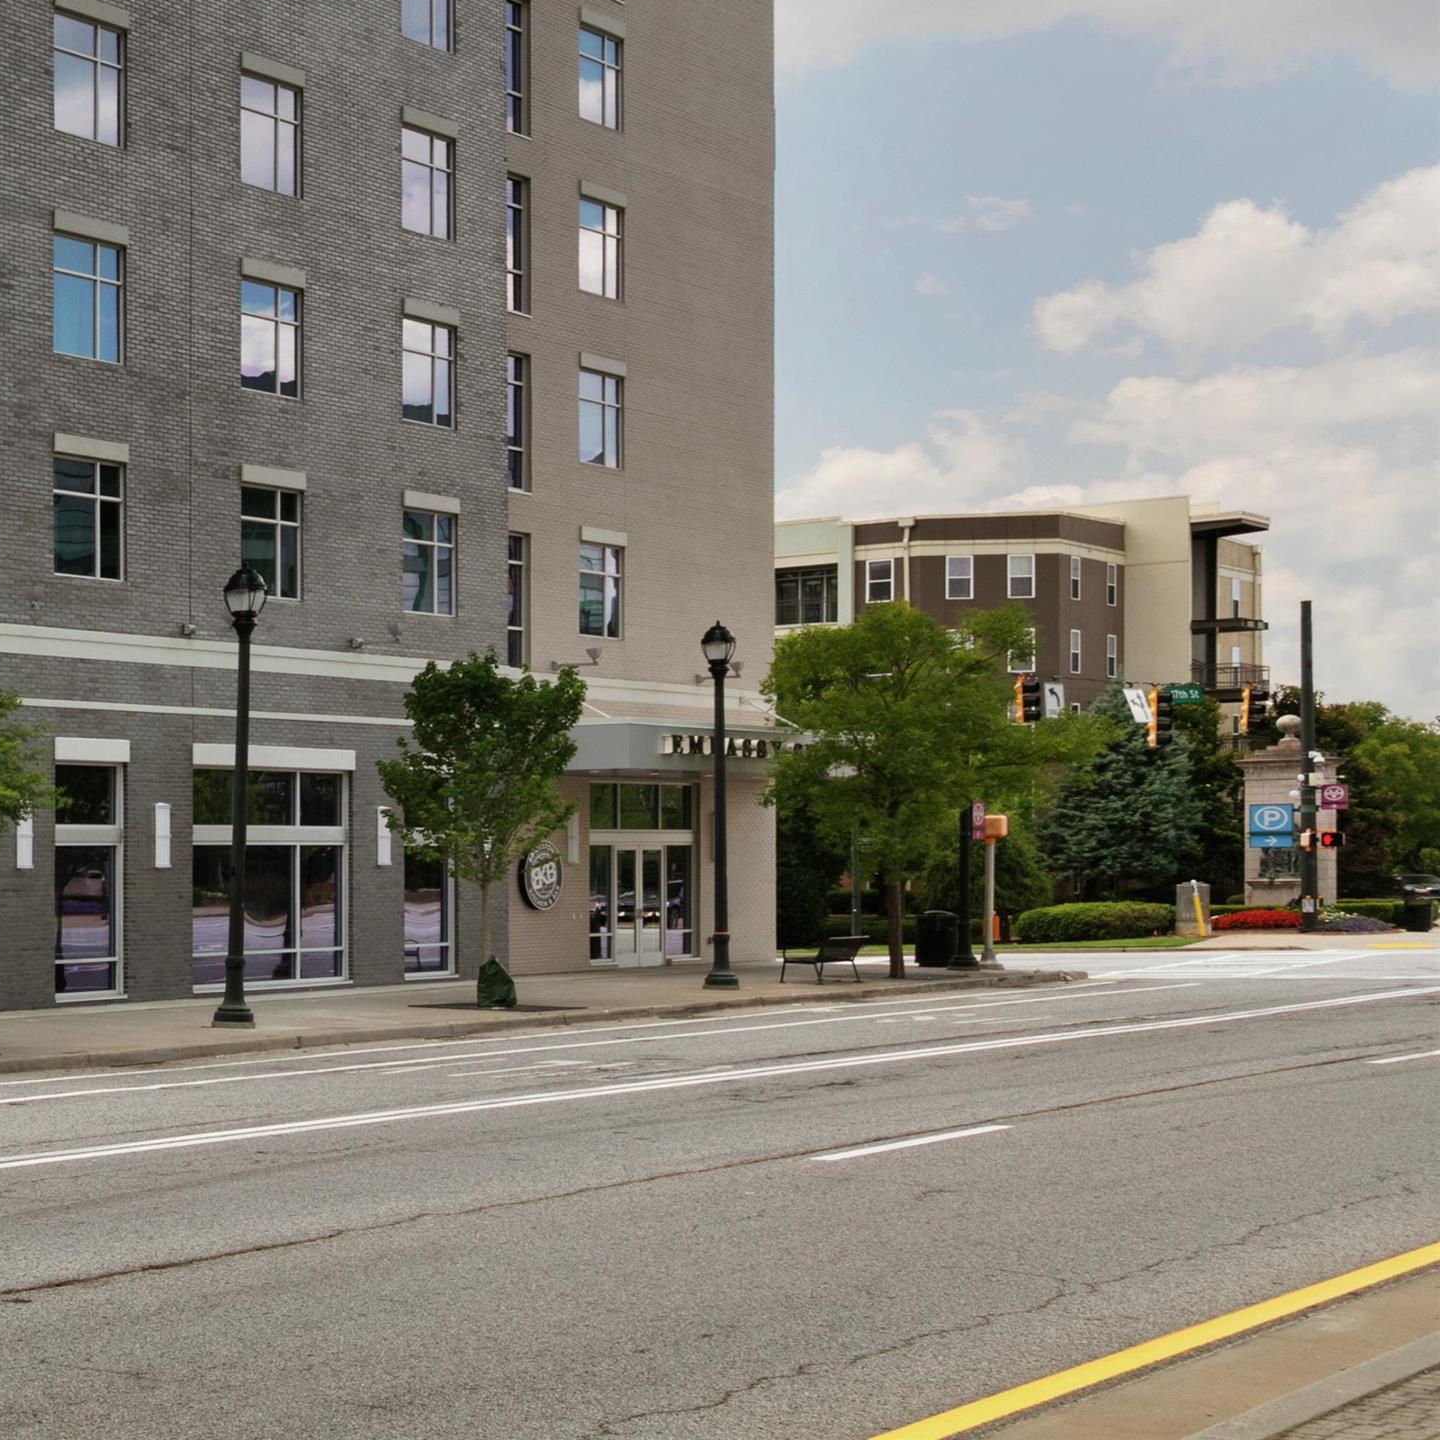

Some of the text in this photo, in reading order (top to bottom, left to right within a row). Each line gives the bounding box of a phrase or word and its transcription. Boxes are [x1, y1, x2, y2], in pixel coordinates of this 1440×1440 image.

[1170, 689, 1200, 699] 17th St
[670, 734, 783, 759] EMASSY
[1263, 810, 1280, 826] P
